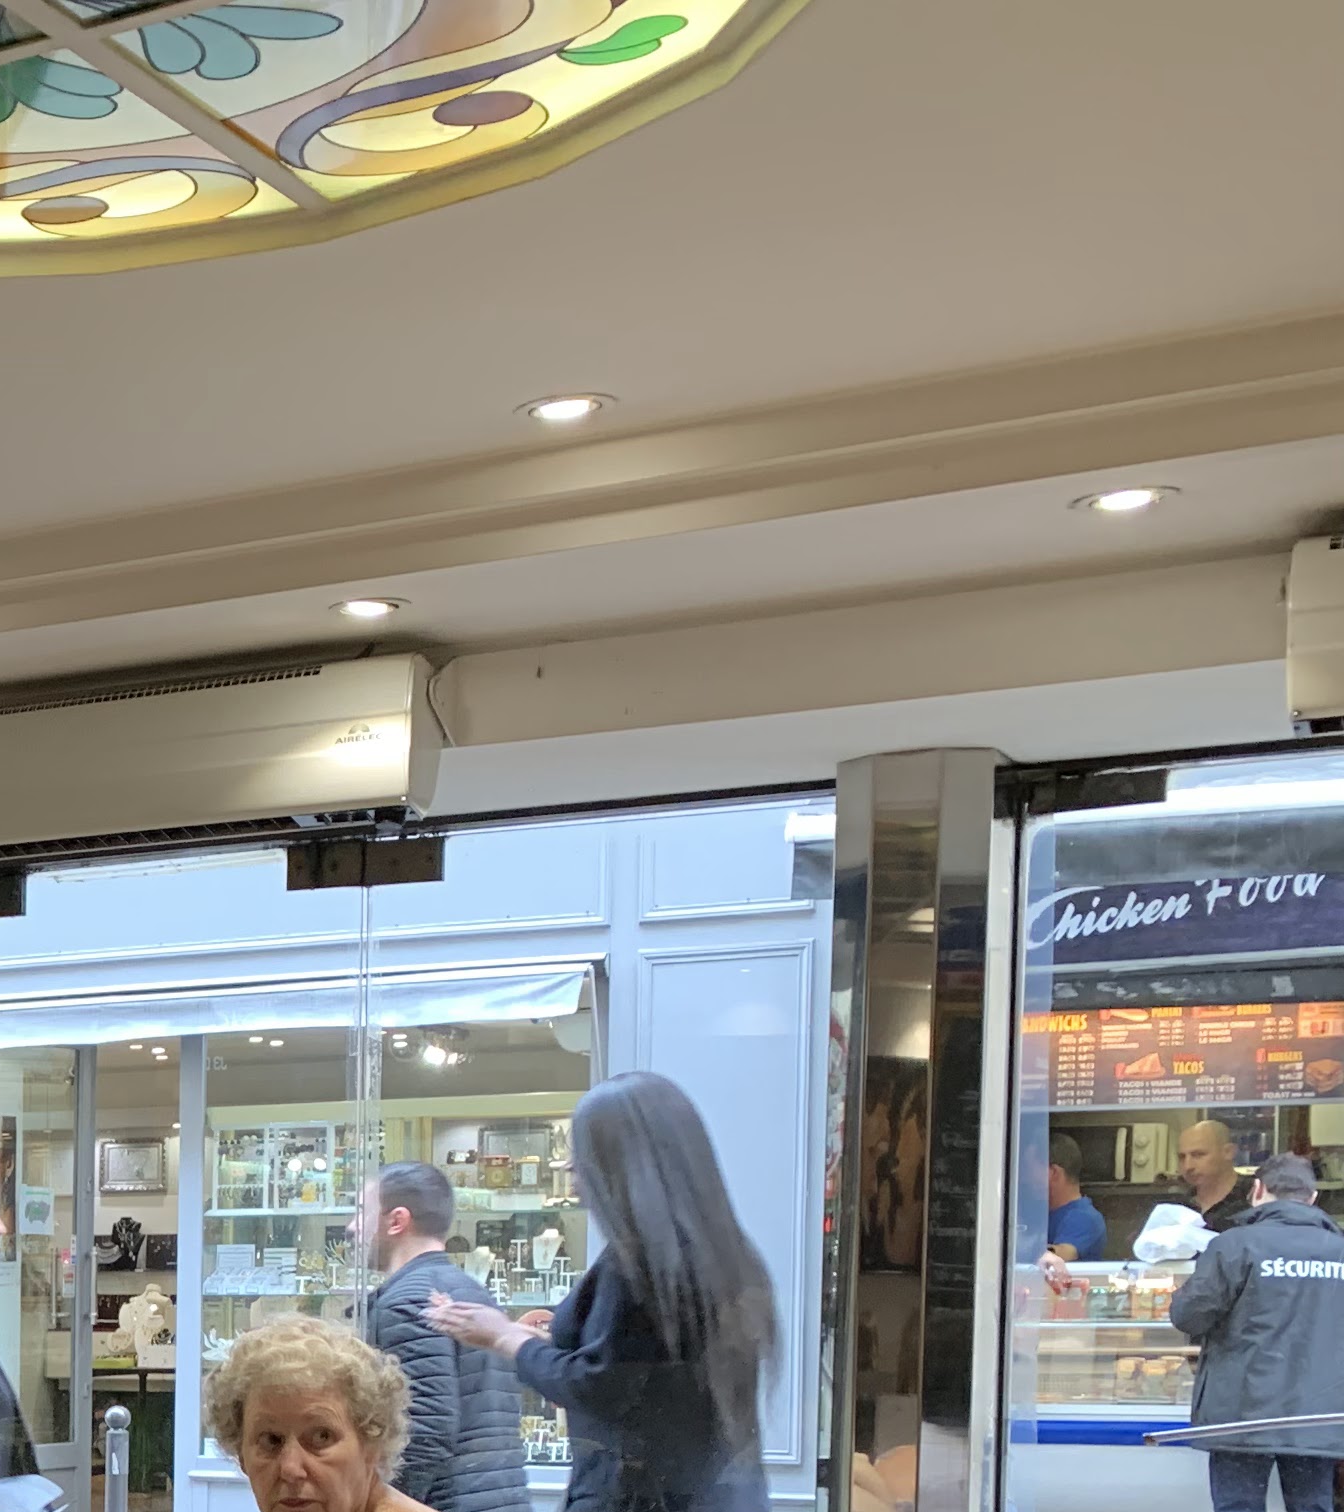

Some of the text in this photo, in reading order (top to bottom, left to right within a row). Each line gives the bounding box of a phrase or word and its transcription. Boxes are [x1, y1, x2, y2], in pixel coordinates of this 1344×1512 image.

[1026, 886, 1192, 950] Chicken
[1173, 1061, 1205, 1074] TACOS
[1260, 1257, 1344, 1280] SÉCURIT
